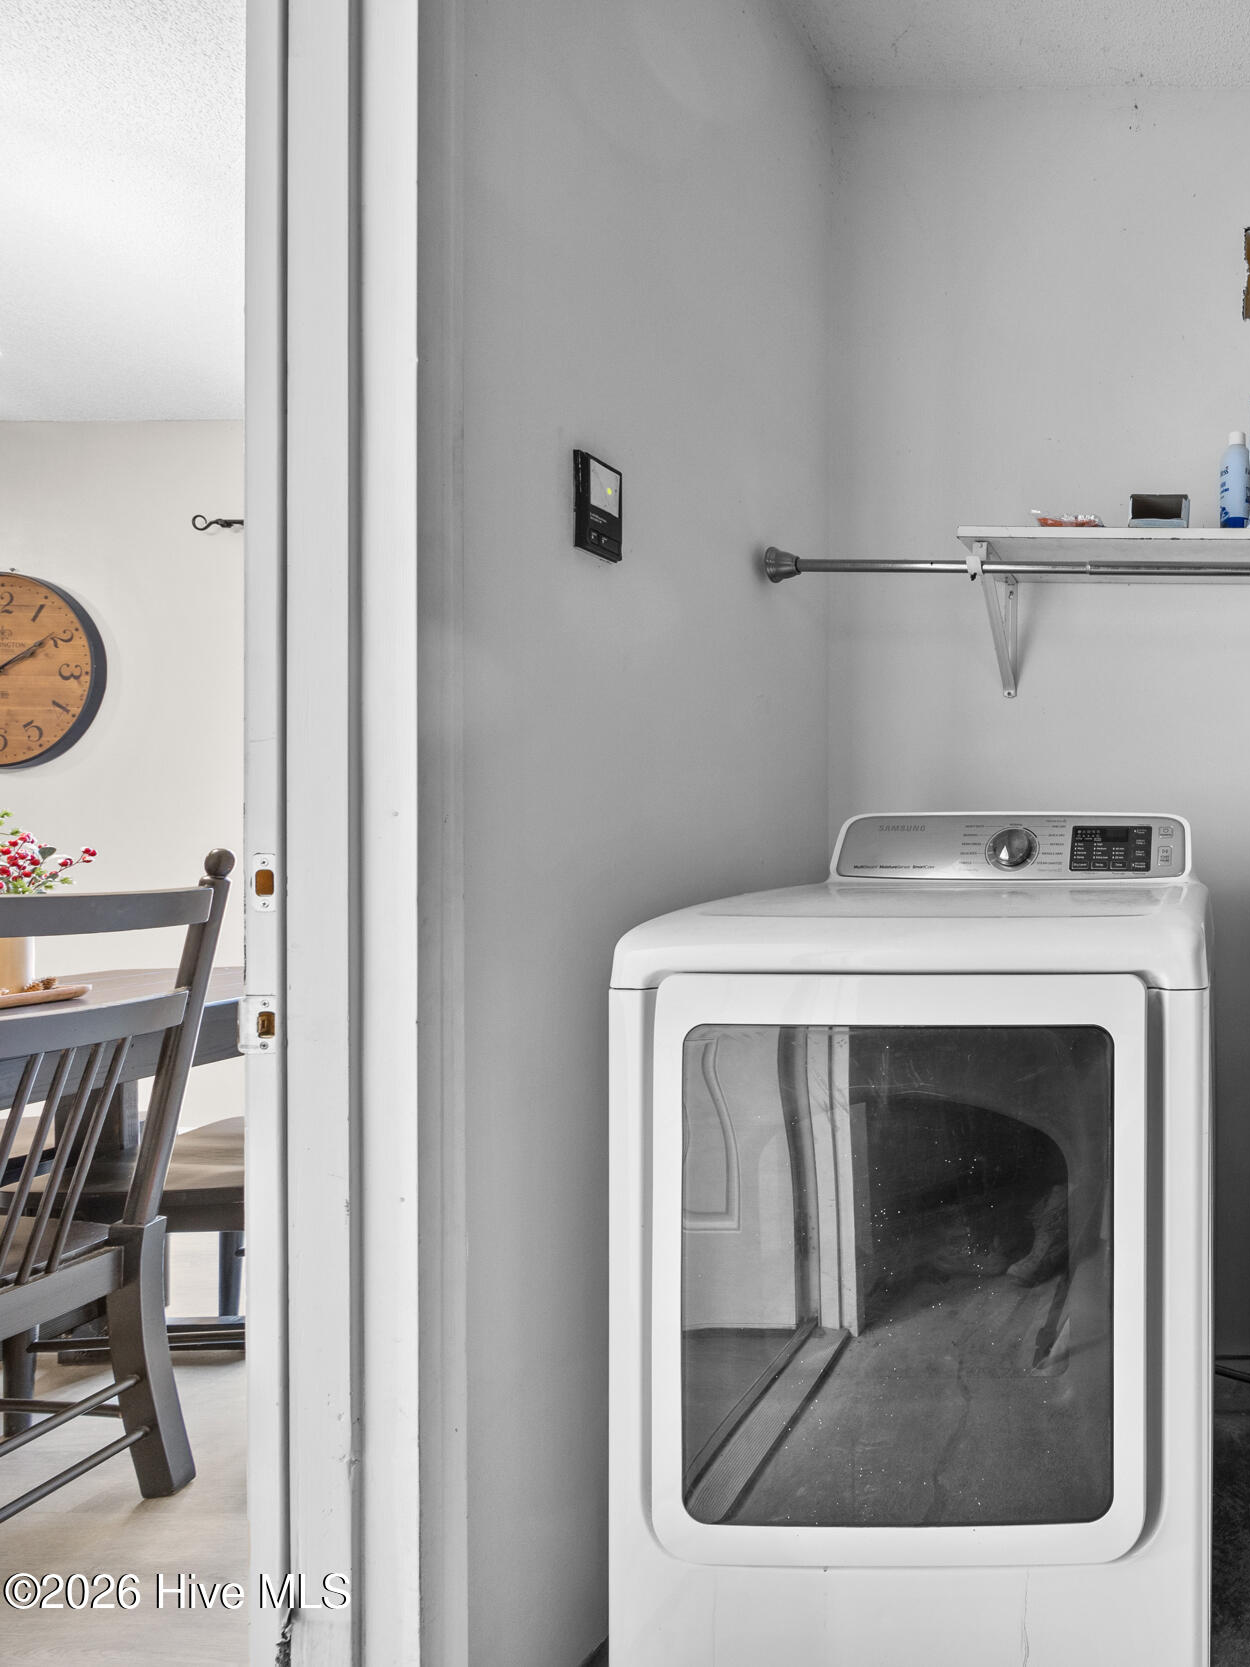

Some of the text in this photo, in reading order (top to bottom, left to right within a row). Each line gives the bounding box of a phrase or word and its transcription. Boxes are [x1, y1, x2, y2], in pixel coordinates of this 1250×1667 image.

[31, 603, 46, 622] 1
[0, 641, 26, 649] NGTON
[50, 629, 74, 649] 2
[58, 662, 83, 681] 3
[22, 720, 44, 743] 5
[879, 824, 926, 832] SAMSUNG
